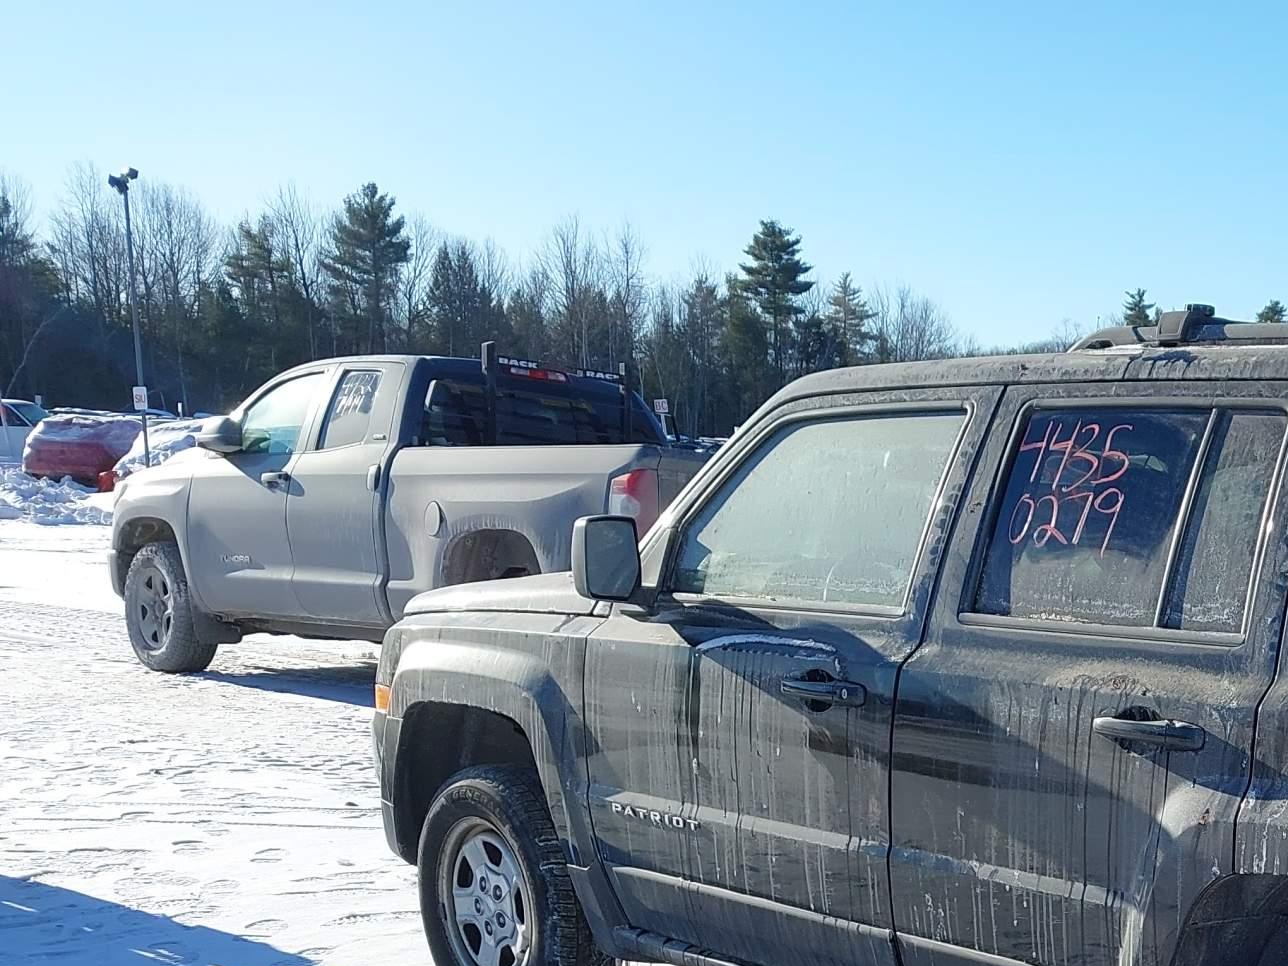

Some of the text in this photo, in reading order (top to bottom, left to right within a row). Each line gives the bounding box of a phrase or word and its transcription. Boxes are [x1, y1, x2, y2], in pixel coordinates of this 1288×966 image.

[498, 357, 538, 369] BACK
[1020, 418, 1133, 493] 4435
[1008, 487, 1125, 559] 0279
[611, 802, 700, 831] PATRIOT
